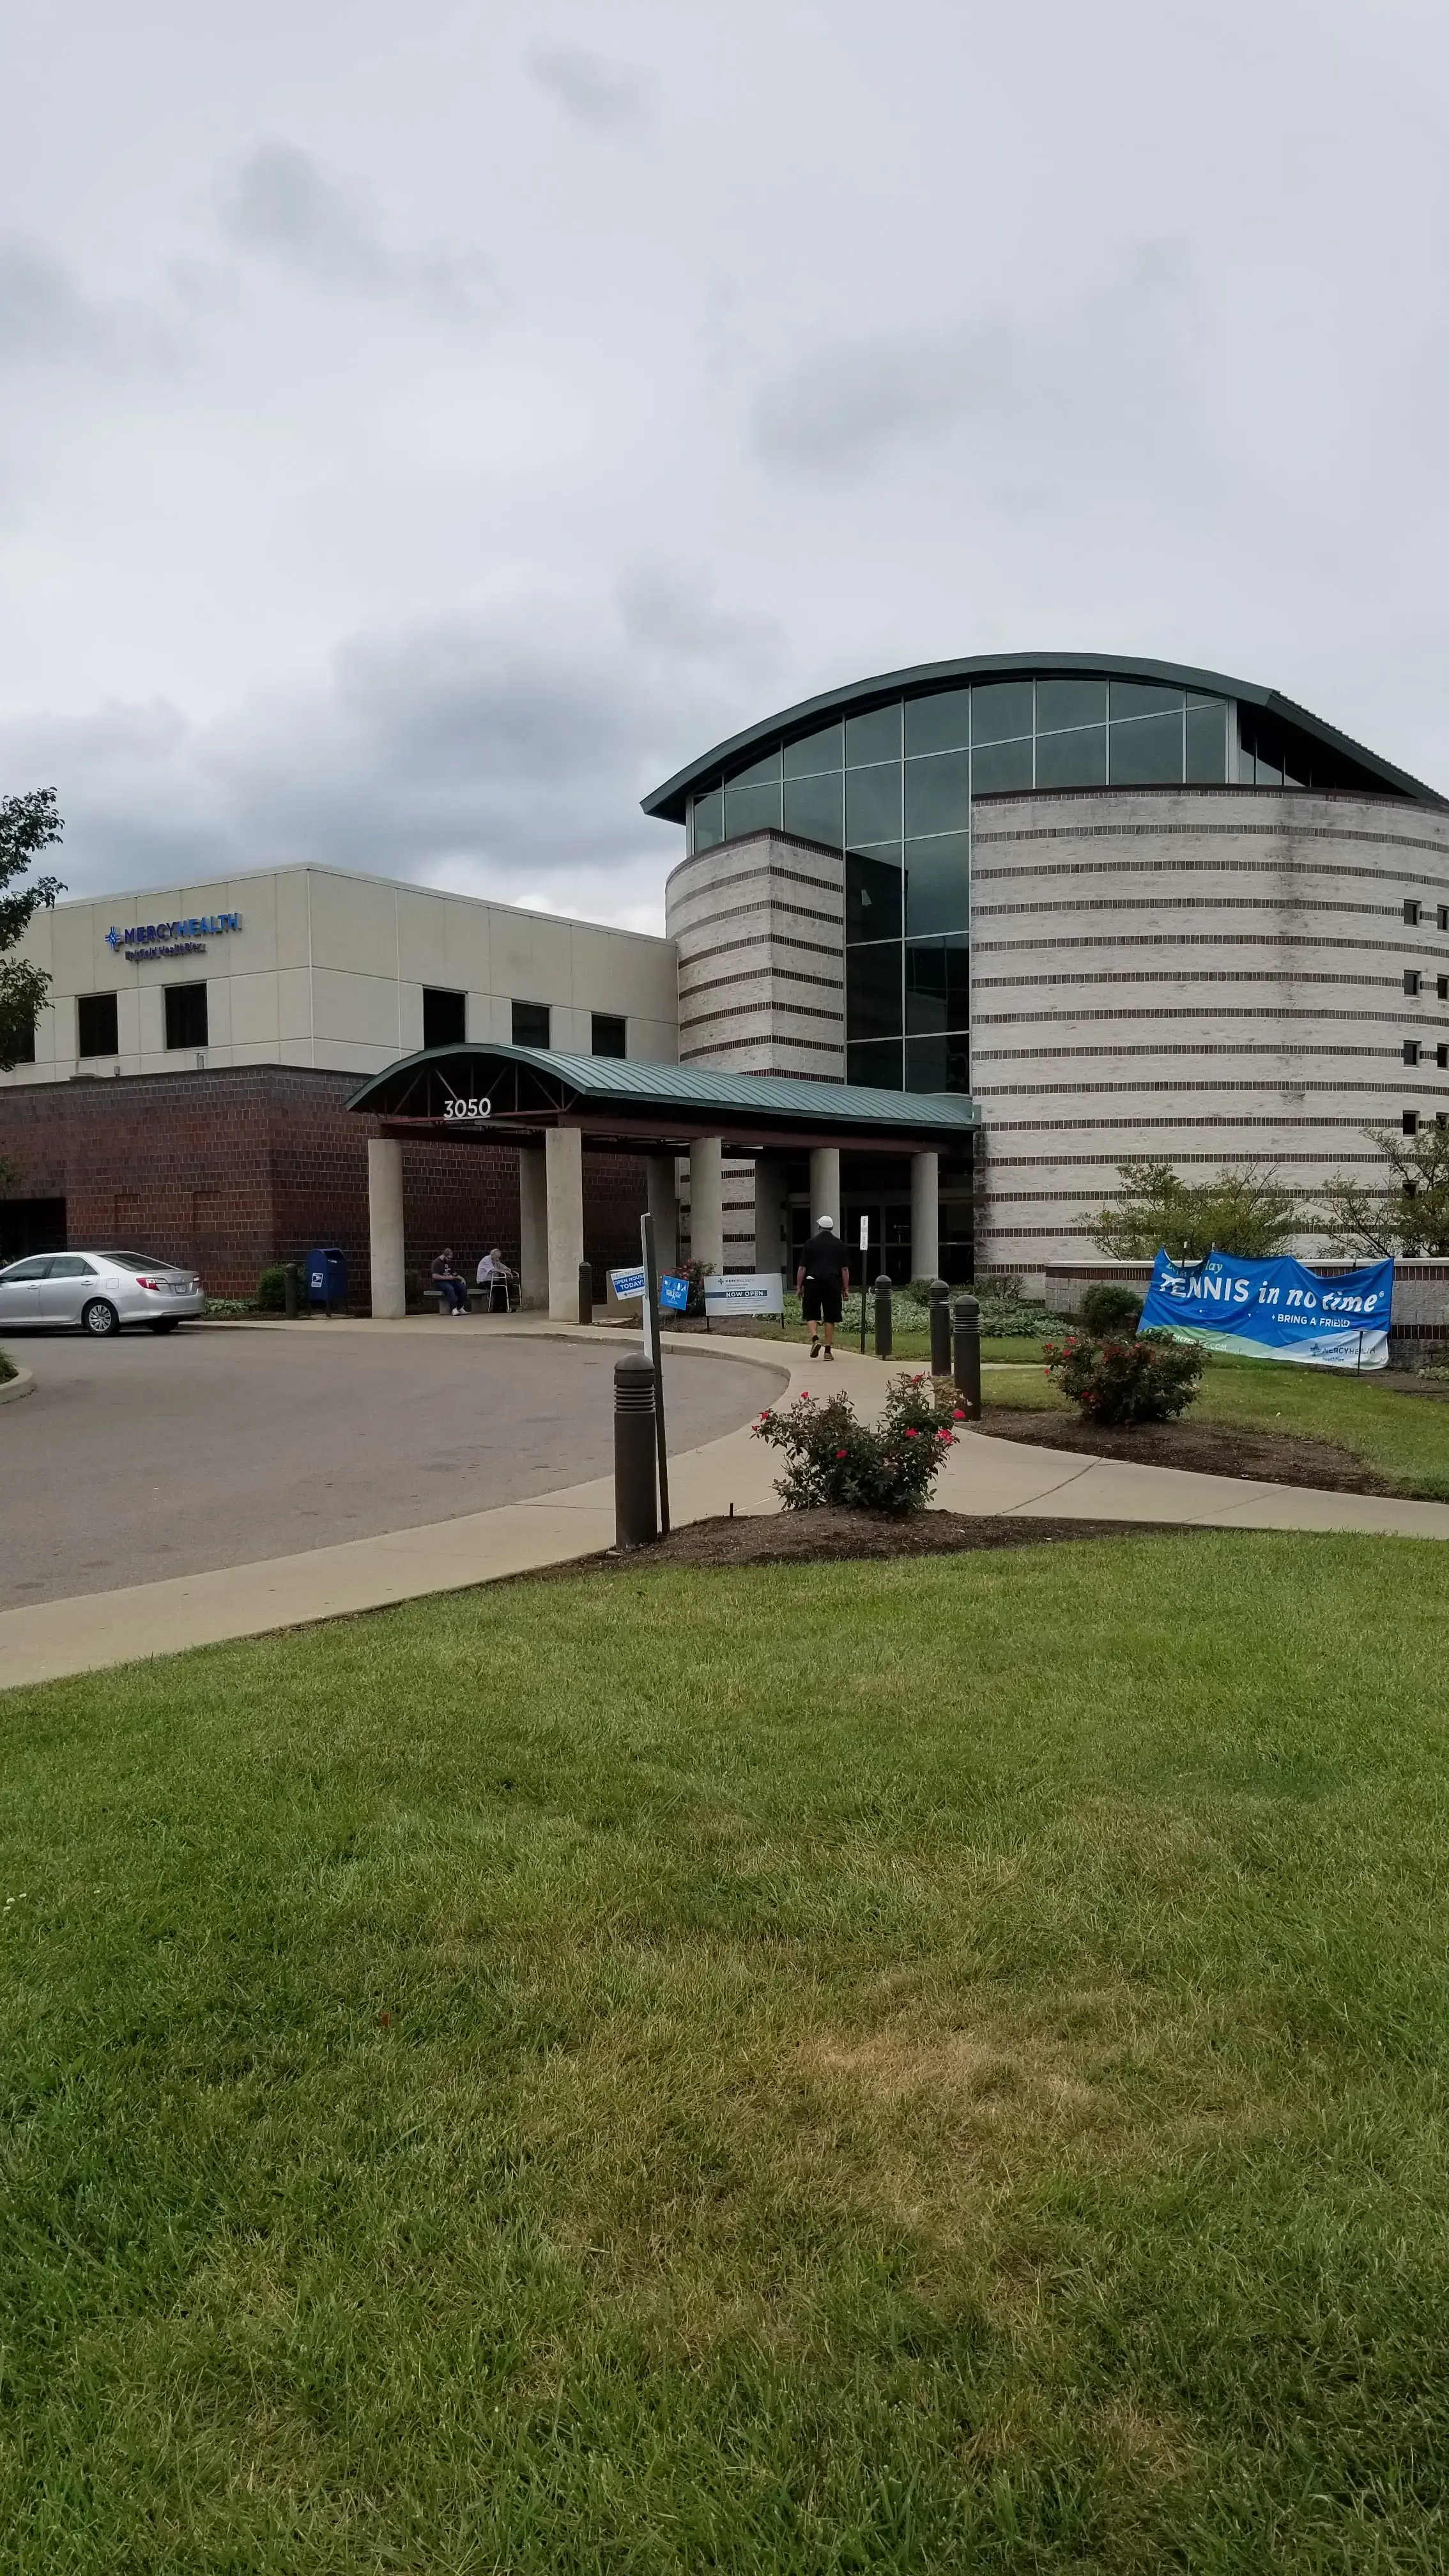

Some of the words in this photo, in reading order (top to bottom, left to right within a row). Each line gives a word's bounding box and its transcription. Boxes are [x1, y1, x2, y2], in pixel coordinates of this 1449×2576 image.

[443, 1098, 491, 1118] 3050
[620, 1279, 645, 1290] TODAY!
[1159, 1273, 1250, 1303] TENNIS
[1258, 1280, 1280, 1305] in
[1286, 1289, 1317, 1308] no
[1277, 1314, 1308, 1324] BRING
[1310, 1317, 1317, 1326] A
[1319, 1317, 1351, 1328] FRIEND
[1322, 1347, 1376, 1355] MERCYHELTH
